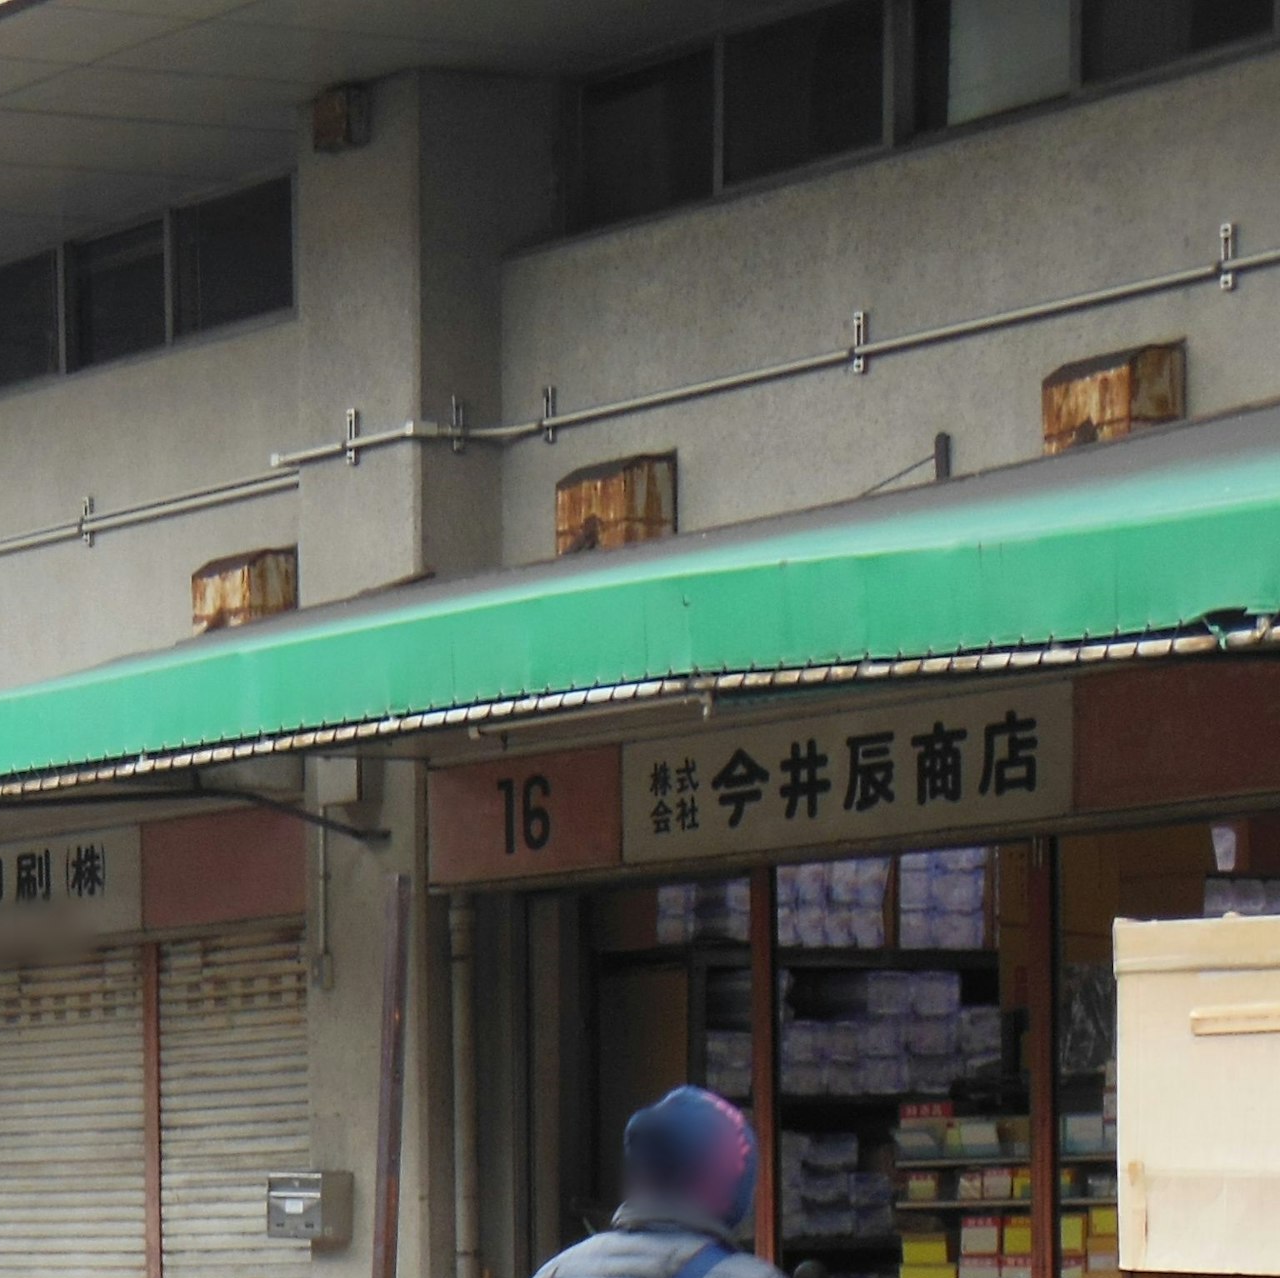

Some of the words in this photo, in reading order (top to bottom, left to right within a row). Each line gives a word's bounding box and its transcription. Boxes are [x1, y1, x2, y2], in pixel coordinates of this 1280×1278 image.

[650, 757, 700, 797] 株式
[711, 709, 1039, 828] 今井辰商店
[497, 774, 551, 854] 16
[650, 797, 700, 834] 会社
